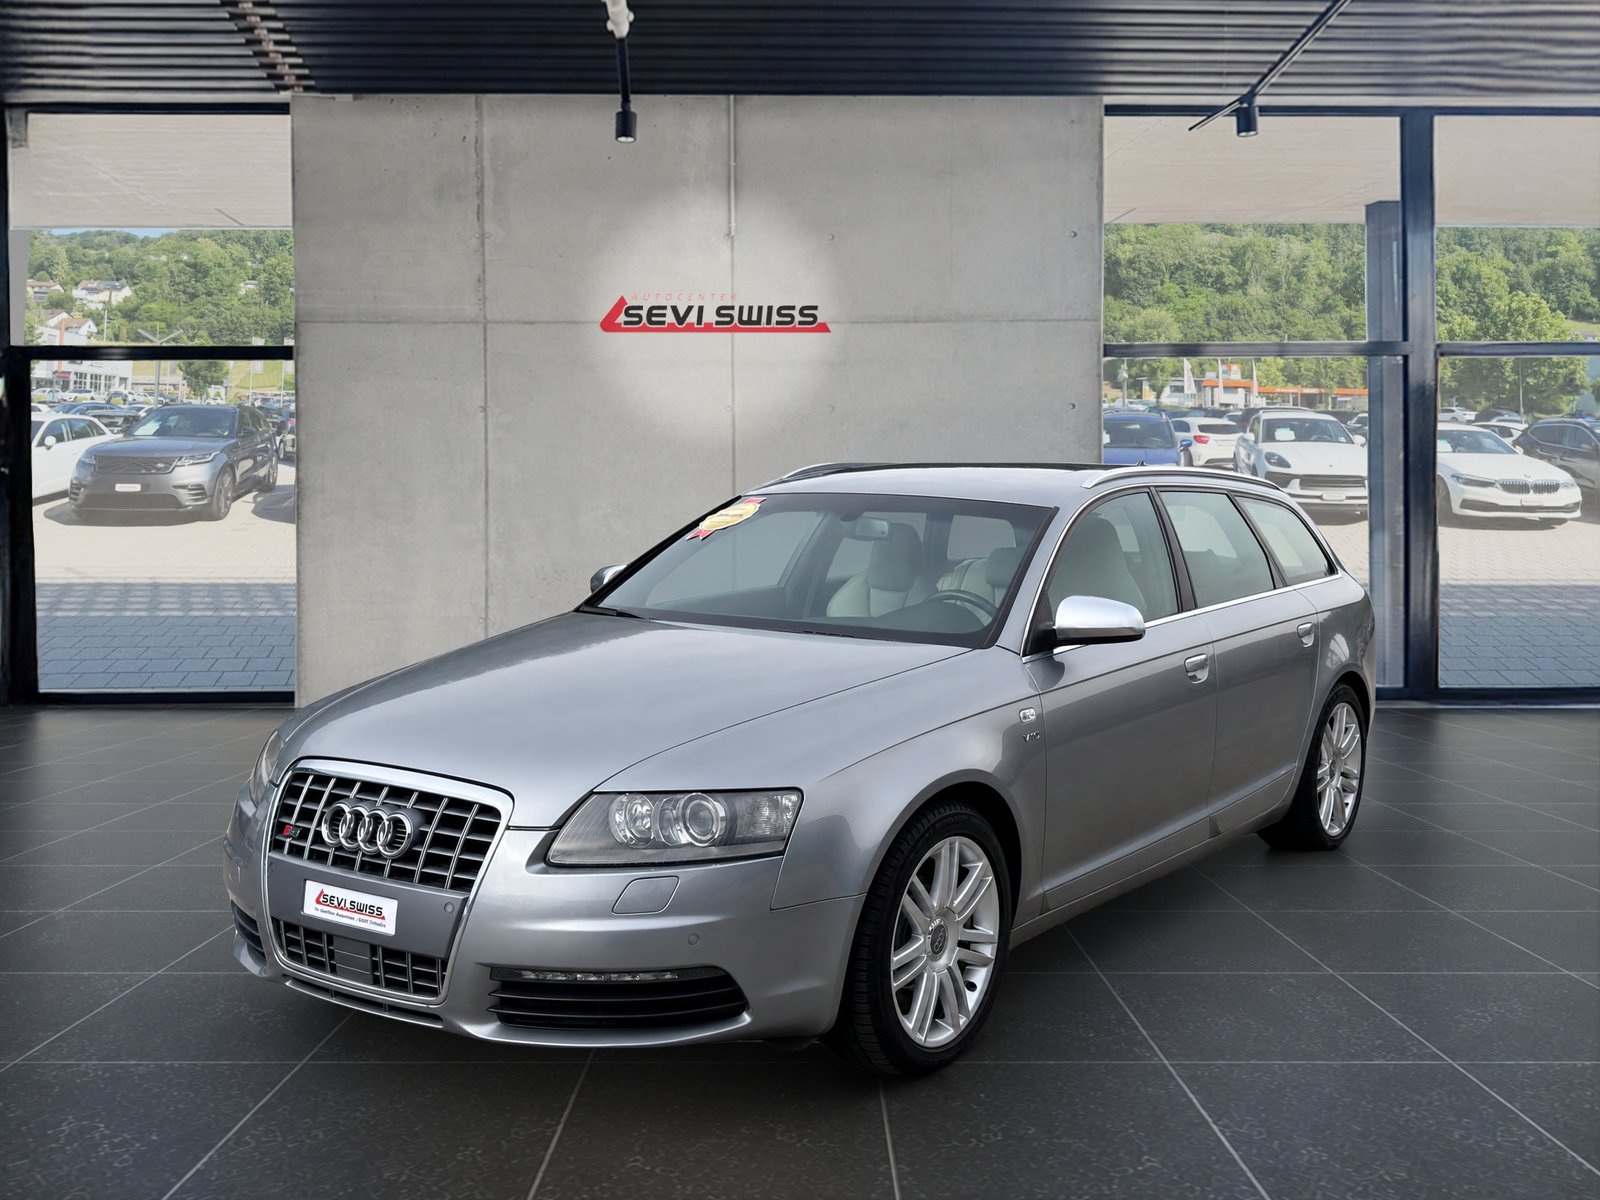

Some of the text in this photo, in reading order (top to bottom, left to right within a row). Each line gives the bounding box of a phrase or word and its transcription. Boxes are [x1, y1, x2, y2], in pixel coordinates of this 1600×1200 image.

[631, 293, 737, 301] AUTOCENTER
[623, 305, 819, 326] SEVI SWISS
[321, 893, 347, 908] SEVI
[349, 900, 384, 917] SWISS
